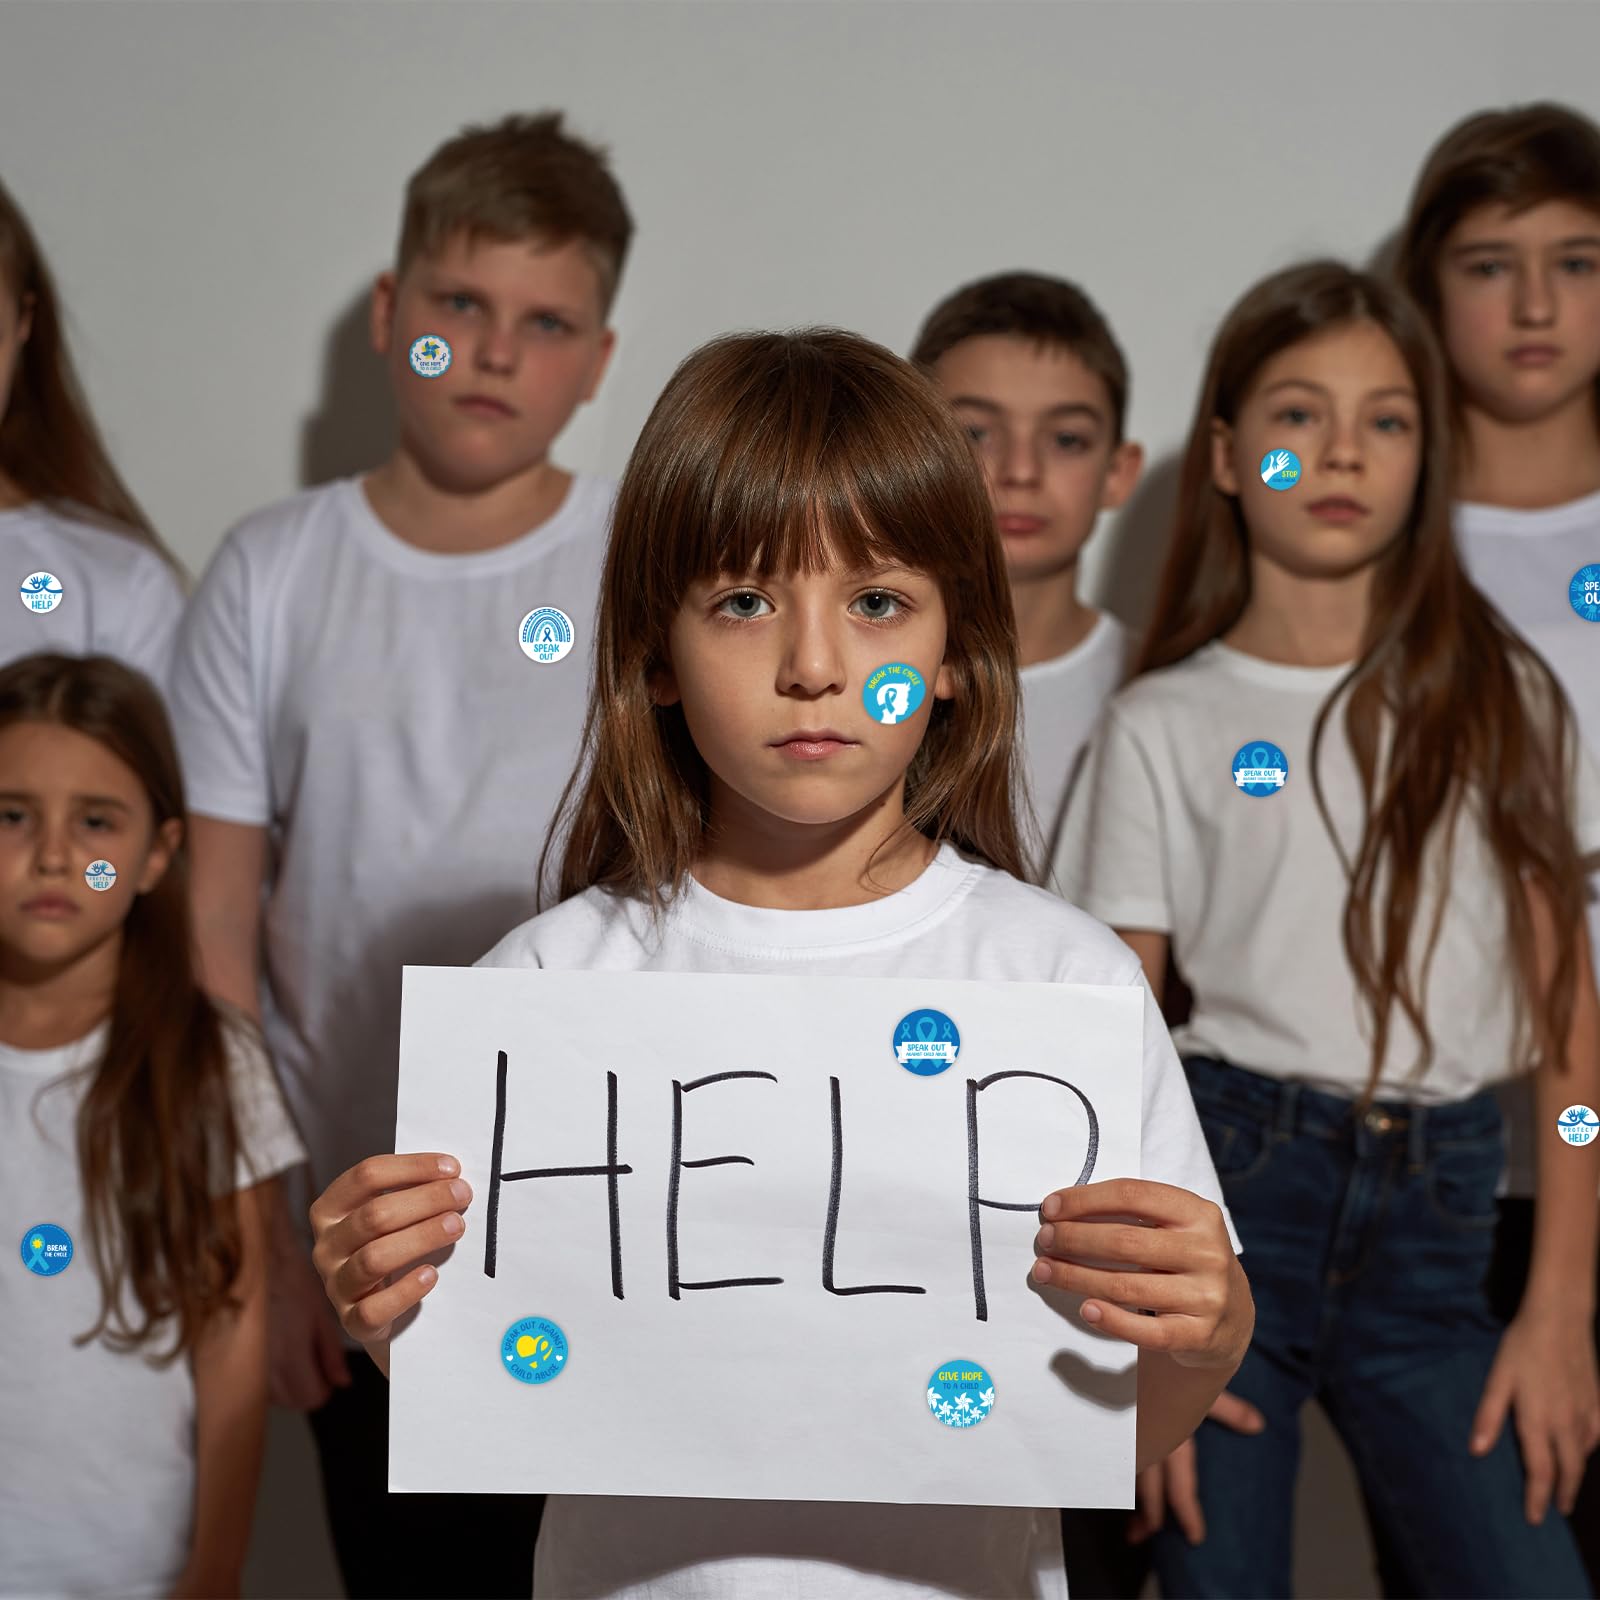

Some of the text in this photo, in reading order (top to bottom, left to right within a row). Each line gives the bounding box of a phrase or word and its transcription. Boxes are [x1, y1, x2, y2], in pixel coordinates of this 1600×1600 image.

[1584, 582, 1600, 590] SPE
[1585, 592, 1600, 604] OU
[32, 600, 52, 609] HELP
[534, 644, 560, 652] SPEAK
[868, 670, 886, 688] BREAK
[902, 668, 920, 685] CYCLE
[1569, 1134, 1589, 1142] HELP
[484, 1050, 1099, 1321] HELP
[505, 1321, 564, 1351] SPEAK OUT AGAINST
[511, 1364, 559, 1380] CHILD ABUSE
[939, 1372, 983, 1380] GIVE HOPE
